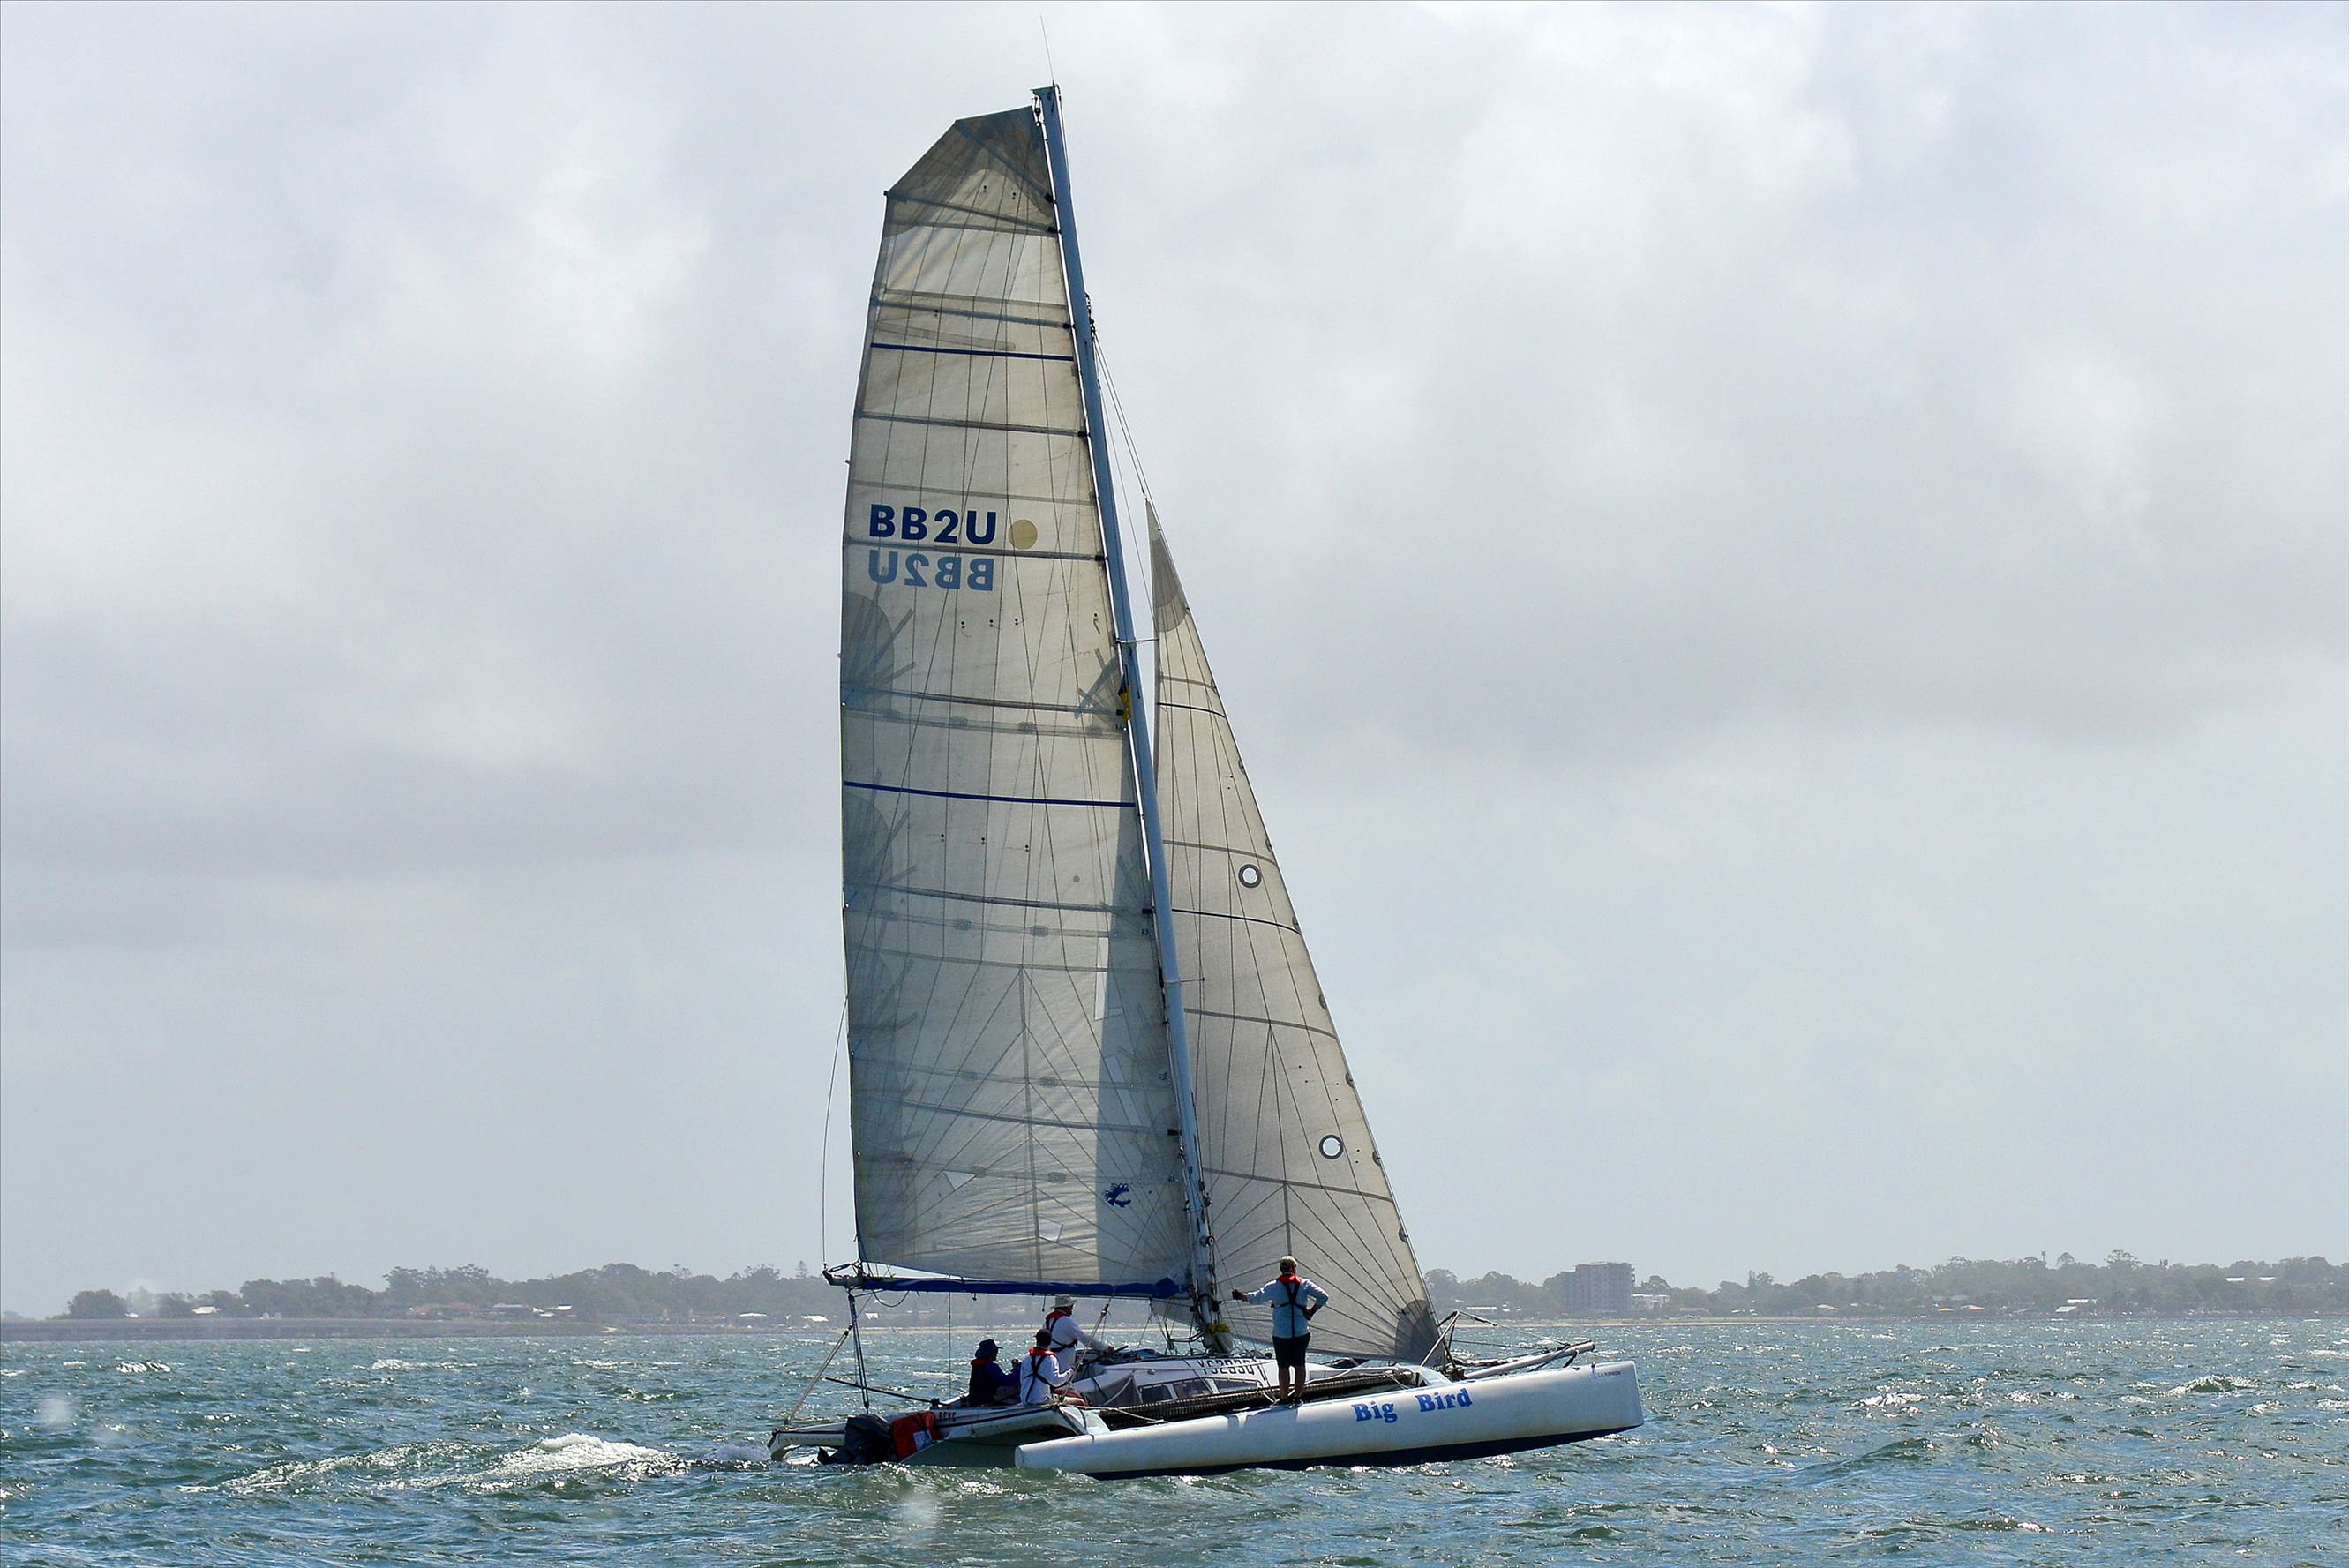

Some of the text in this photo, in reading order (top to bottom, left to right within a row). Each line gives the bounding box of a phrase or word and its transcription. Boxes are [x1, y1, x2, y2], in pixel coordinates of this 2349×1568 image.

[869, 504, 997, 544] BB2U
[1351, 1388, 1473, 1423] Big Bird
